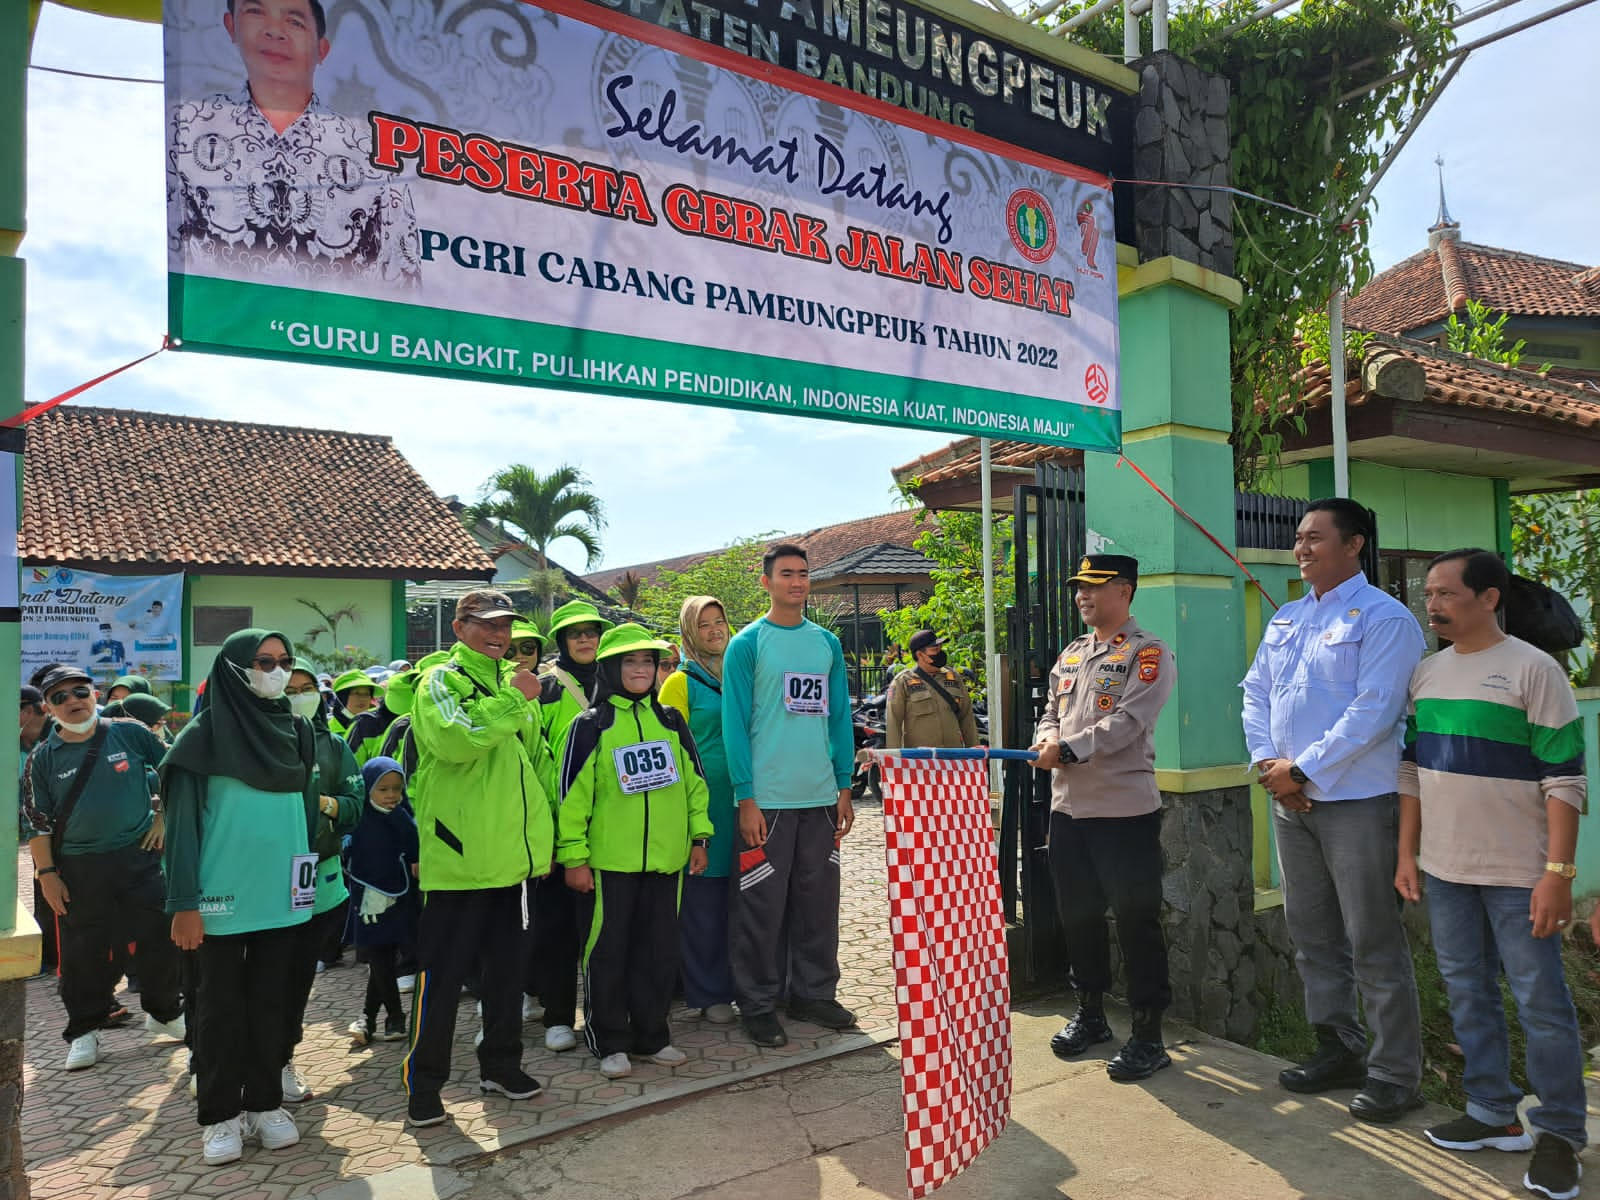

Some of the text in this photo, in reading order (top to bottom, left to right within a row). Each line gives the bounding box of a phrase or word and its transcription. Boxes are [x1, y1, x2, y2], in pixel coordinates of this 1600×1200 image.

[744, 0, 1112, 144] AMEUNGPEUK
[797, 40, 975, 130] BANDUNG
[605, 75, 799, 183] Selamat
[814, 133, 953, 244] Datang
[372, 114, 1074, 316] PESERTA GERAK JALAN SEHAT
[420, 228, 1058, 370] PGRI CABANG PAMEUNGPEUK TAHUN 2022
[391, 335, 524, 375] BANGKIT,
[532, 353, 657, 387] PULIHKAN
[664, 370, 798, 407] PENDIDIKAN,
[803, 388, 899, 416] INDONESIA
[903, 401, 948, 424] KUAT,
[952, 409, 1031, 434] INDONESIA
[46, 605, 96, 615] BANDUNG
[56, 588, 128, 606] Datang
[789, 678, 822, 700] 025
[1098, 663, 1127, 674] POLRI
[623, 747, 667, 776] 035
